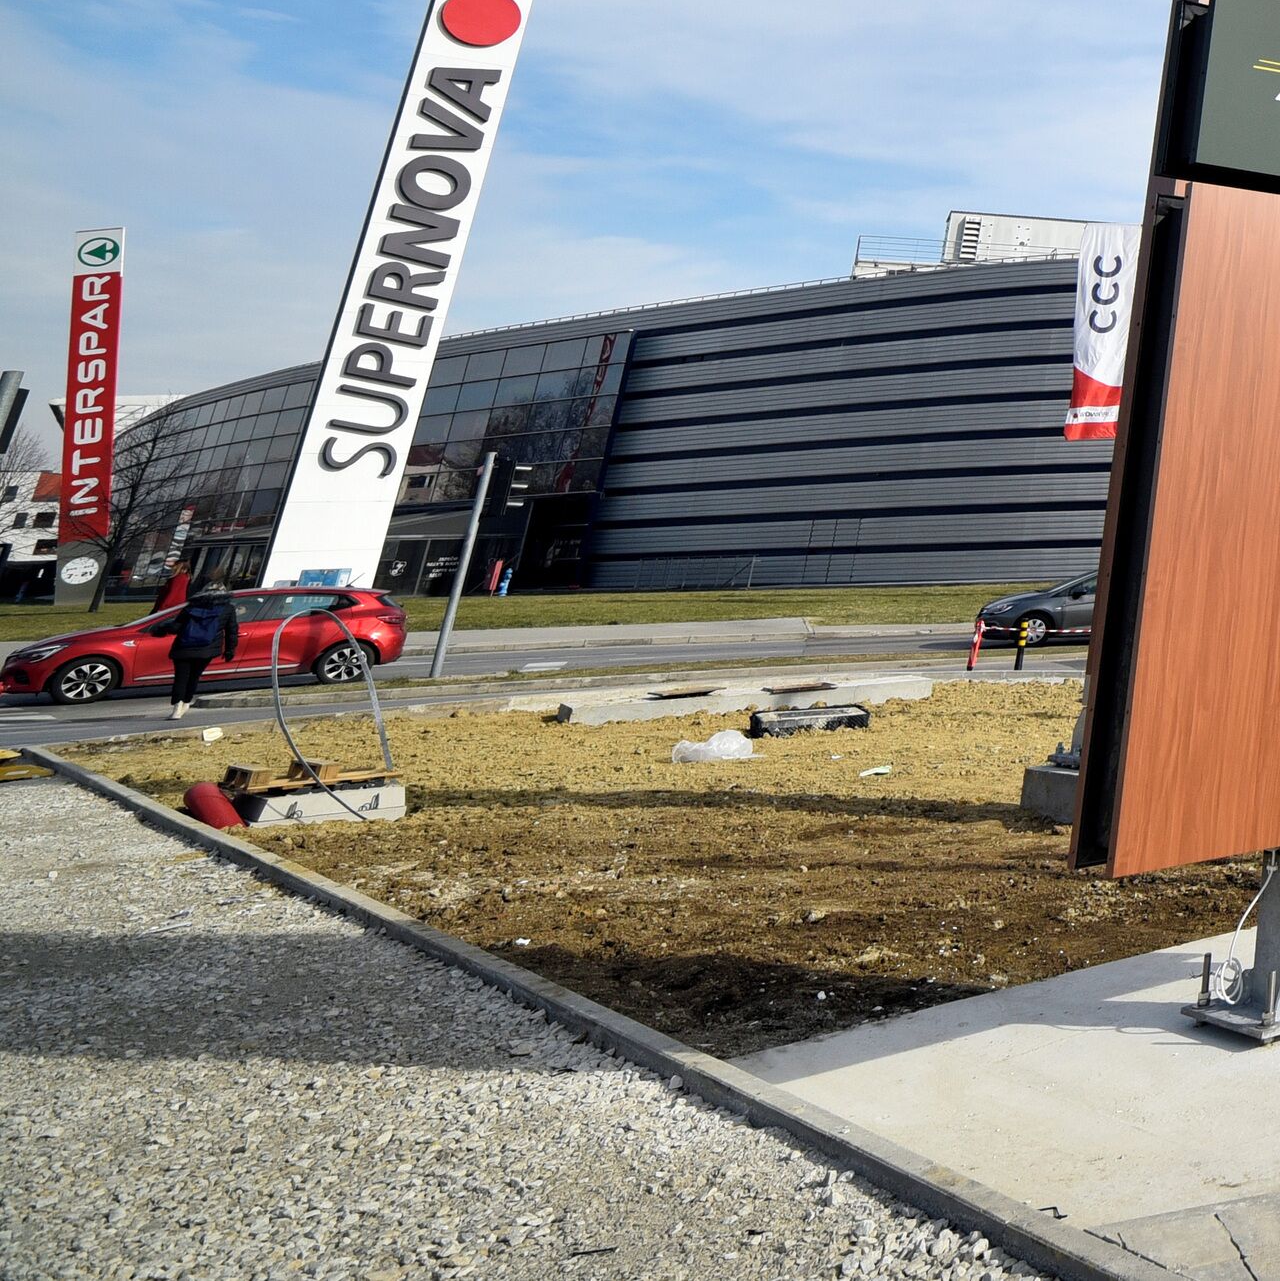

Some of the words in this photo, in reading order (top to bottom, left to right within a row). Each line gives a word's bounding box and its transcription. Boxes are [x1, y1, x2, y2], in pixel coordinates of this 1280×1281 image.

[318, 67, 502, 479] SUPERNOVA
[1088, 254, 1122, 335] CCC
[69, 274, 112, 517] INTERSPAR
